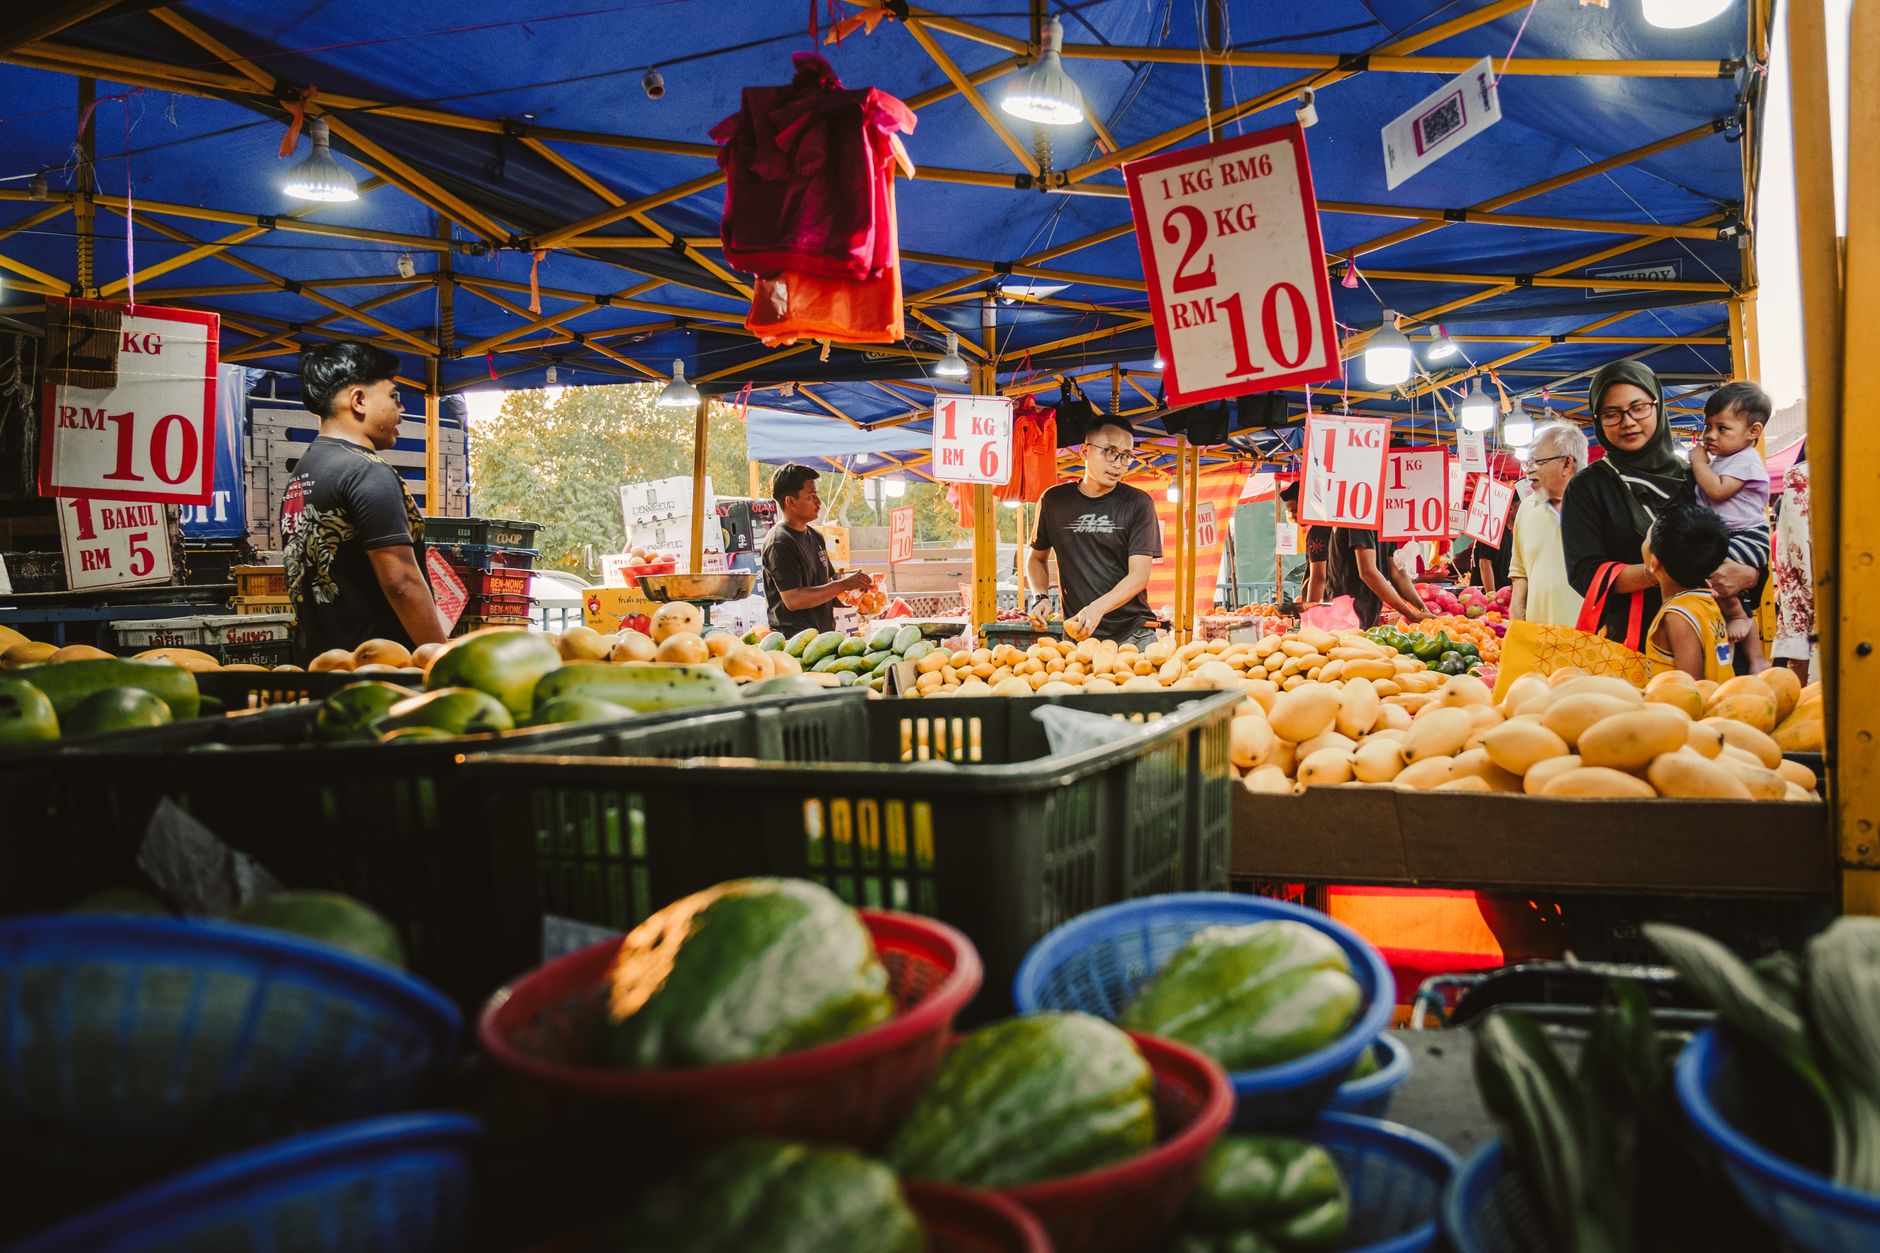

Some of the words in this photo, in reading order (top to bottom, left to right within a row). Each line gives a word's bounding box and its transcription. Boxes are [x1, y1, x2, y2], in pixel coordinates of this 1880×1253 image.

[1160, 178, 1173, 200] 1
[1180, 168, 1214, 193] KG
[1221, 154, 1274, 187] RM6
[1162, 205, 1217, 294] 2
[1213, 203, 1258, 237] KG
[121, 331, 163, 355] KG
[1168, 296, 1218, 330] RM
[1216, 281, 1313, 379] 10
[941, 400, 957, 441] 1
[970, 415, 995, 437] KG
[1347, 427, 1380, 449] KG
[58, 404, 107, 431] RM
[102, 411, 199, 485] 10
[941, 447, 964, 467] RM
[979, 440, 999, 478] 6
[1389, 455, 1407, 490] 1
[1405, 459, 1423, 471] KG
[68, 498, 97, 541] 1
[101, 504, 158, 531] BAKUL
[1384, 497, 1404, 510] RM
[1403, 496, 1443, 533] 10
[80, 547, 112, 572] RM
[129, 531, 155, 576] 5
